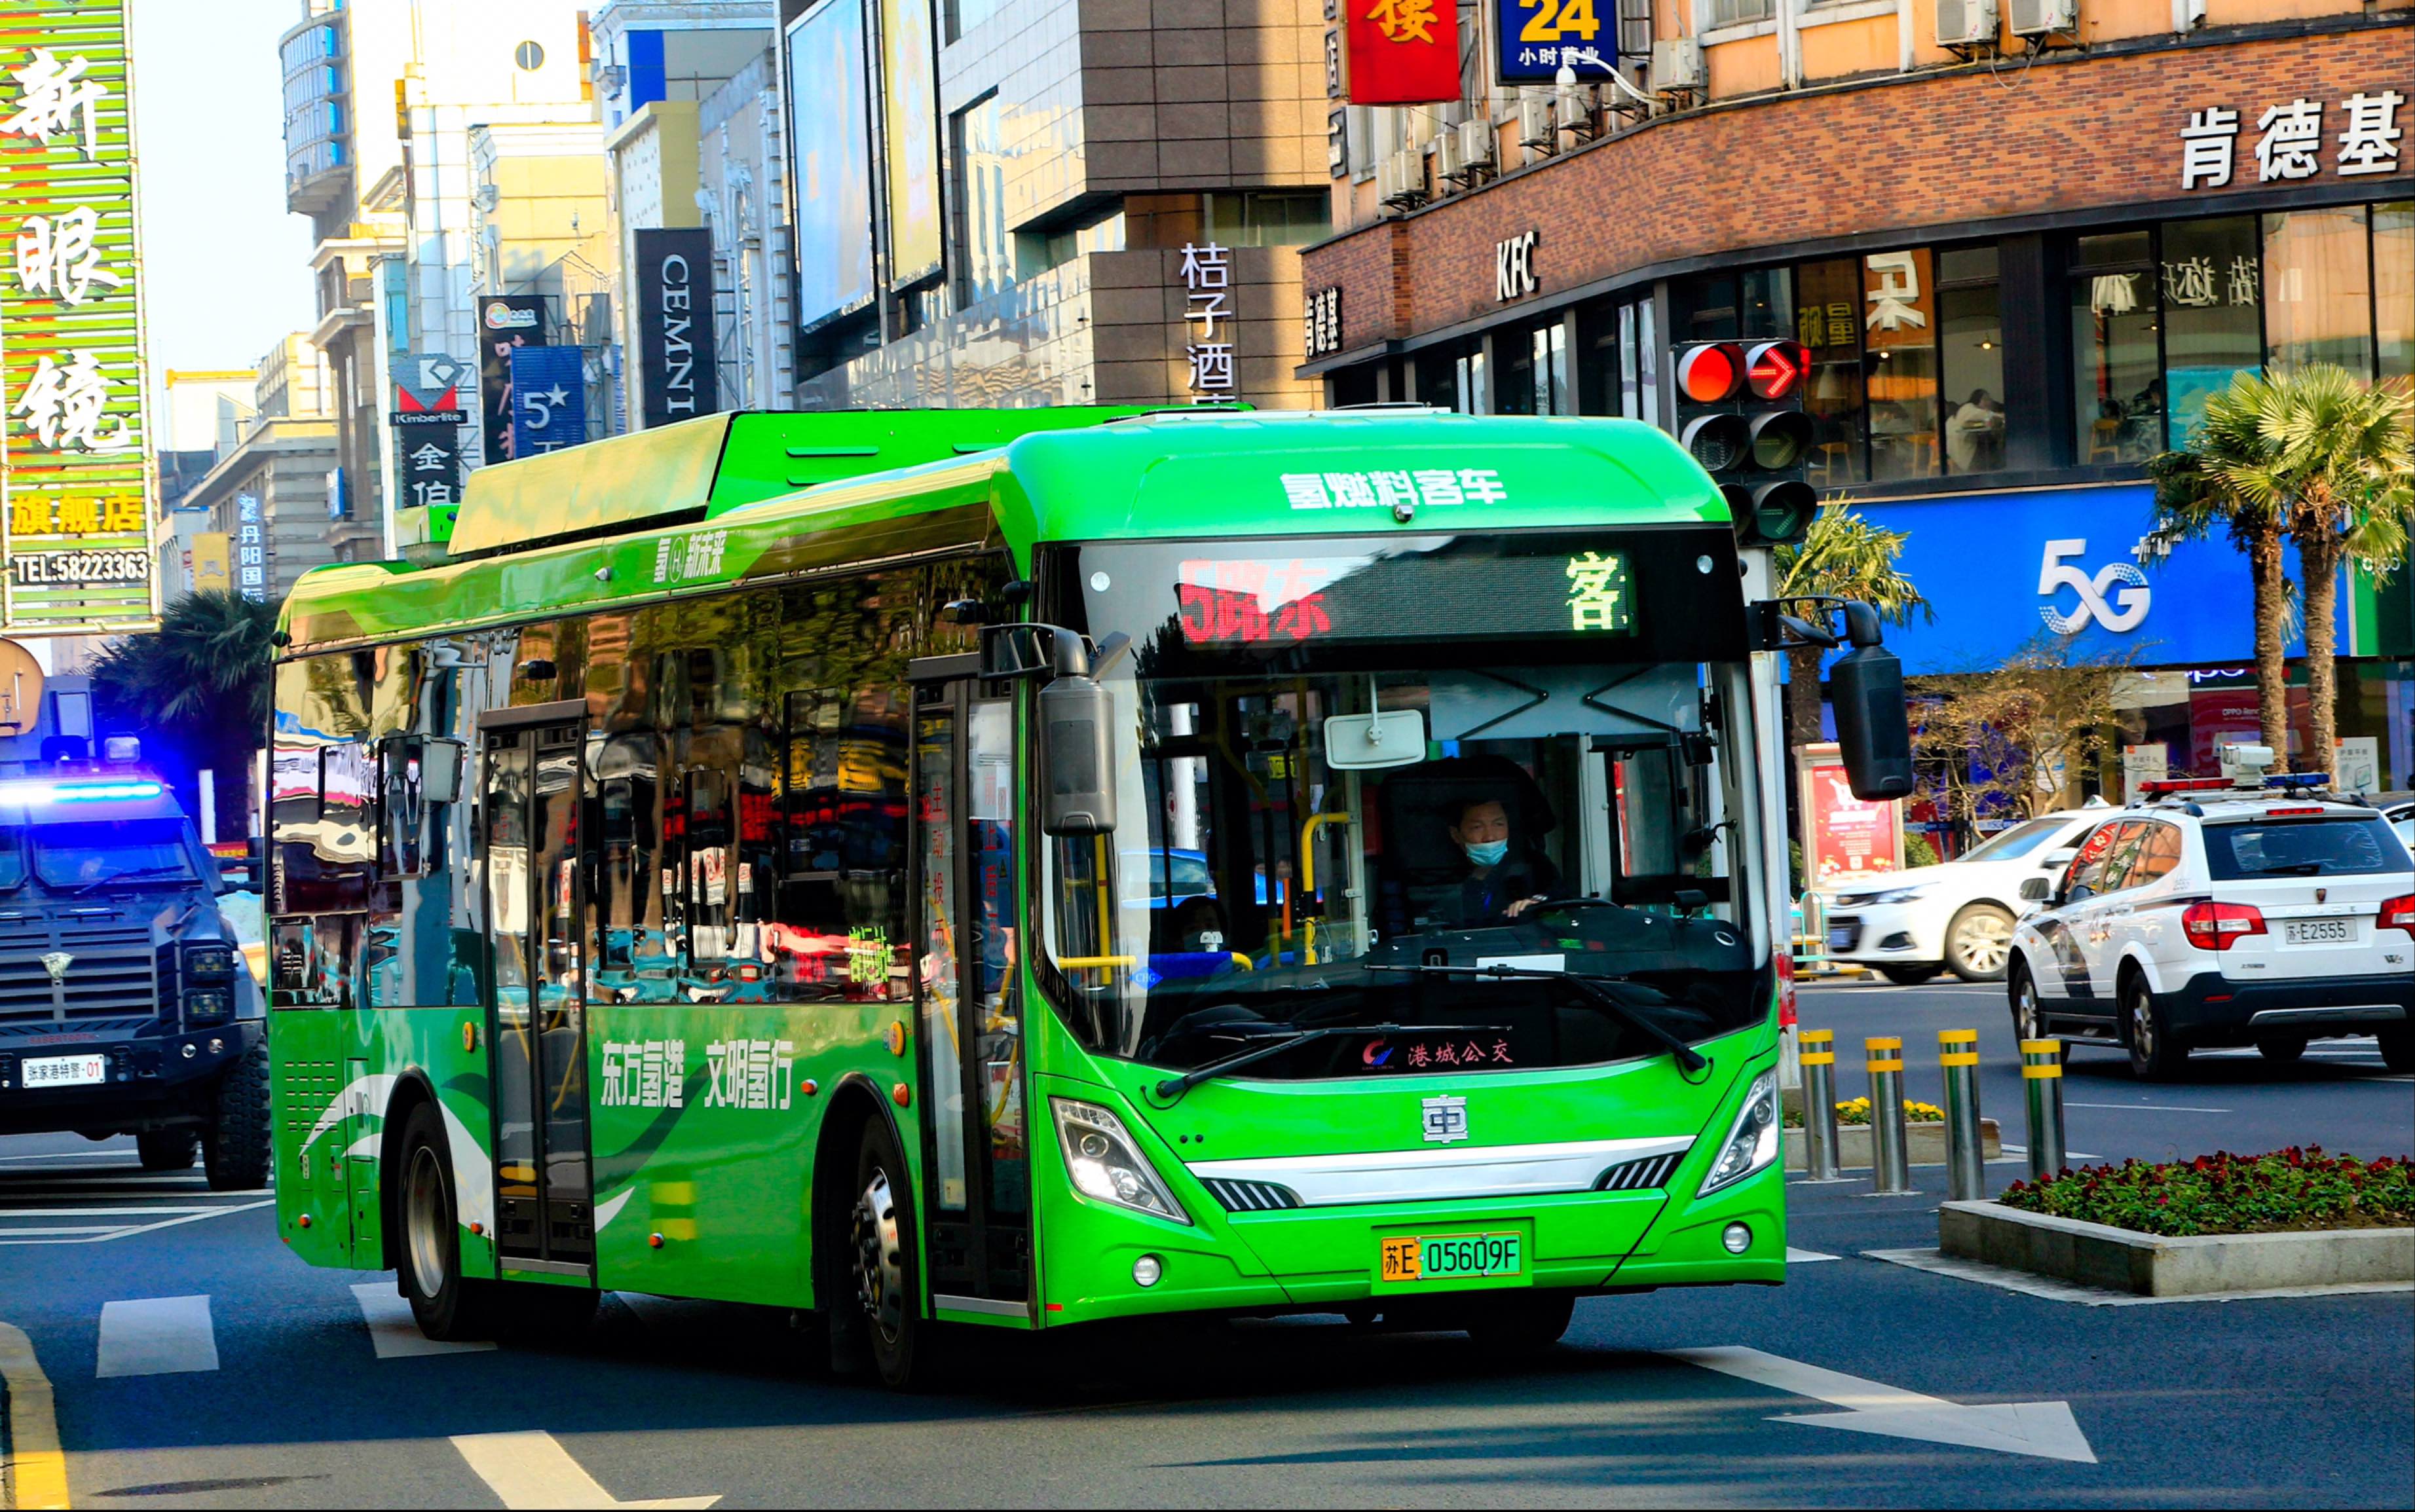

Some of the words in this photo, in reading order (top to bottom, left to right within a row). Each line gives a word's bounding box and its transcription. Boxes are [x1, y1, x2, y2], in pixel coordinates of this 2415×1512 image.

[1519, 0, 1600, 41] 24
[1518, 45, 1600, 67] 小时营业
[2180, 90, 2405, 189] 肯德基
[1496, 230, 1535, 301] KFC
[1180, 242, 1236, 404] 桔子酒
[395, 413, 462, 424] Kimberlite
[1280, 468, 1507, 510] 氢燃料客车
[11, 494, 143, 534] 旗舰店
[14, 553, 149, 582] TEL:58223363
[2038, 538, 2151, 634] 5G
[1408, 1038, 1514, 1067] 港城公交
[600, 1039, 684, 1108] 东方氢港
[703, 1039, 793, 1111] 文明氢行
[1428, 1238, 1518, 1273] 05609F
